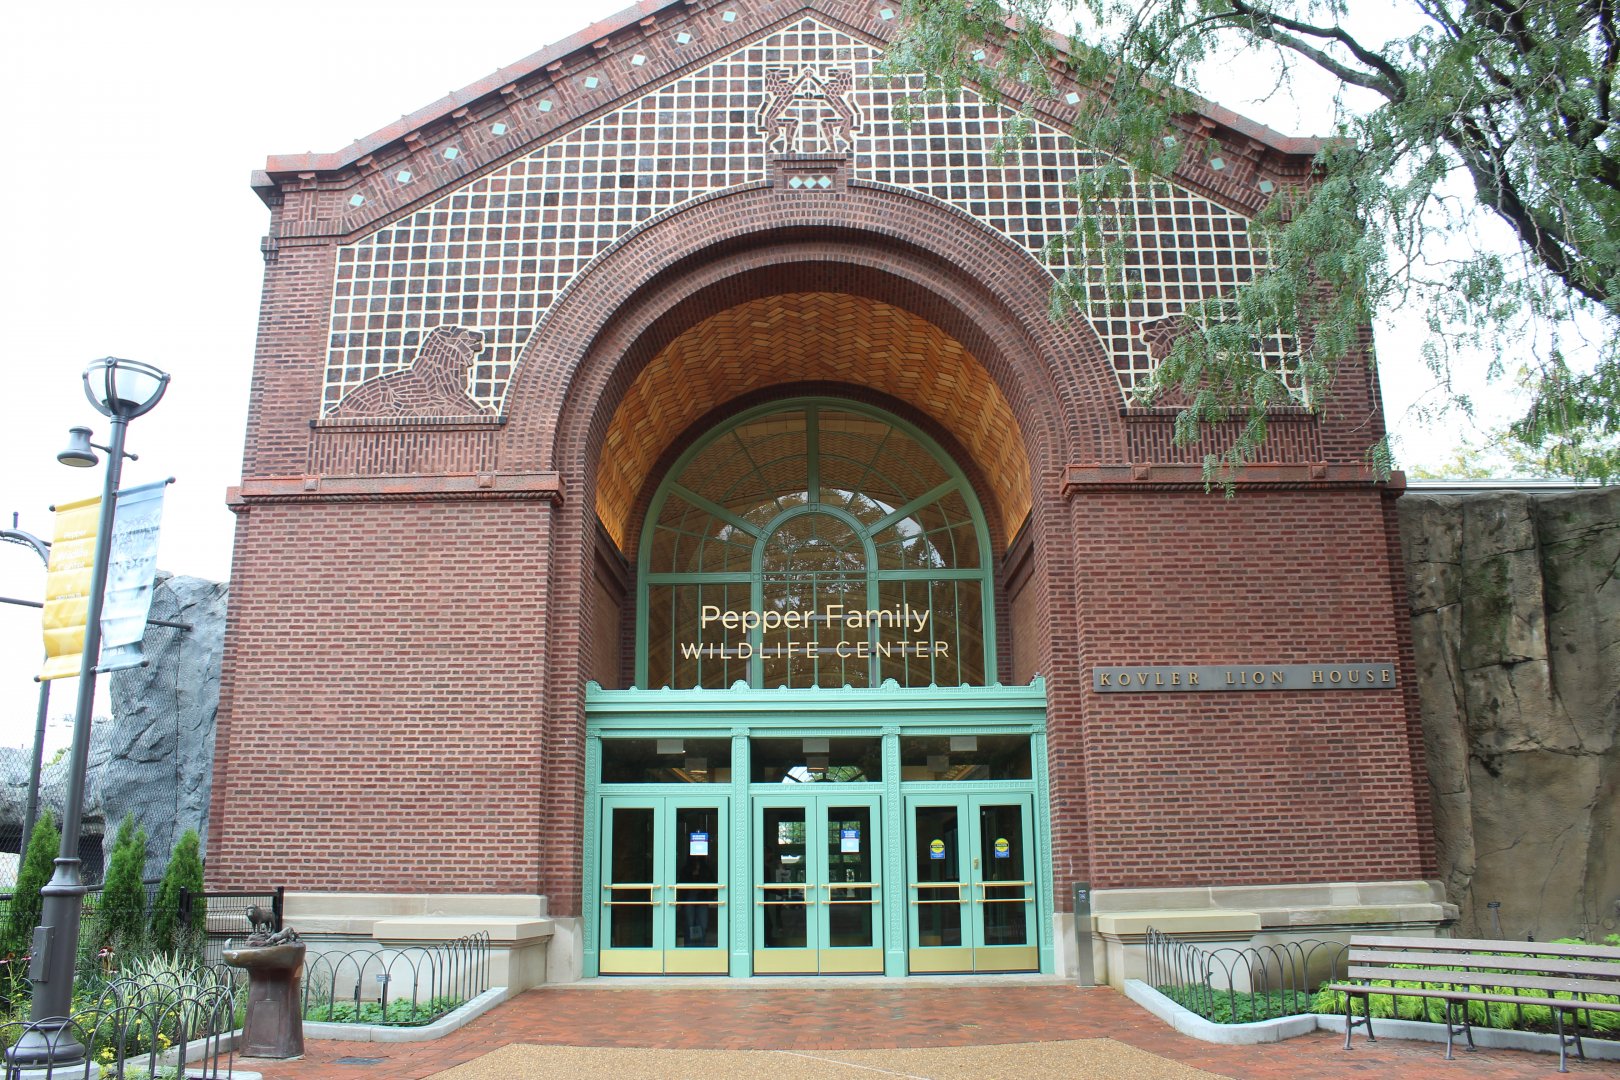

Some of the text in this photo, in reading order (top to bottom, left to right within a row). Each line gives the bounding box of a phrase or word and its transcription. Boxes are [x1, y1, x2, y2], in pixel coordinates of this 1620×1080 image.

[701, 603, 930, 633] Pepper Family
[681, 641, 950, 659] WILDLIFE CENTER
[1100, 669, 1391, 686] KOVLER LION HOUSE
